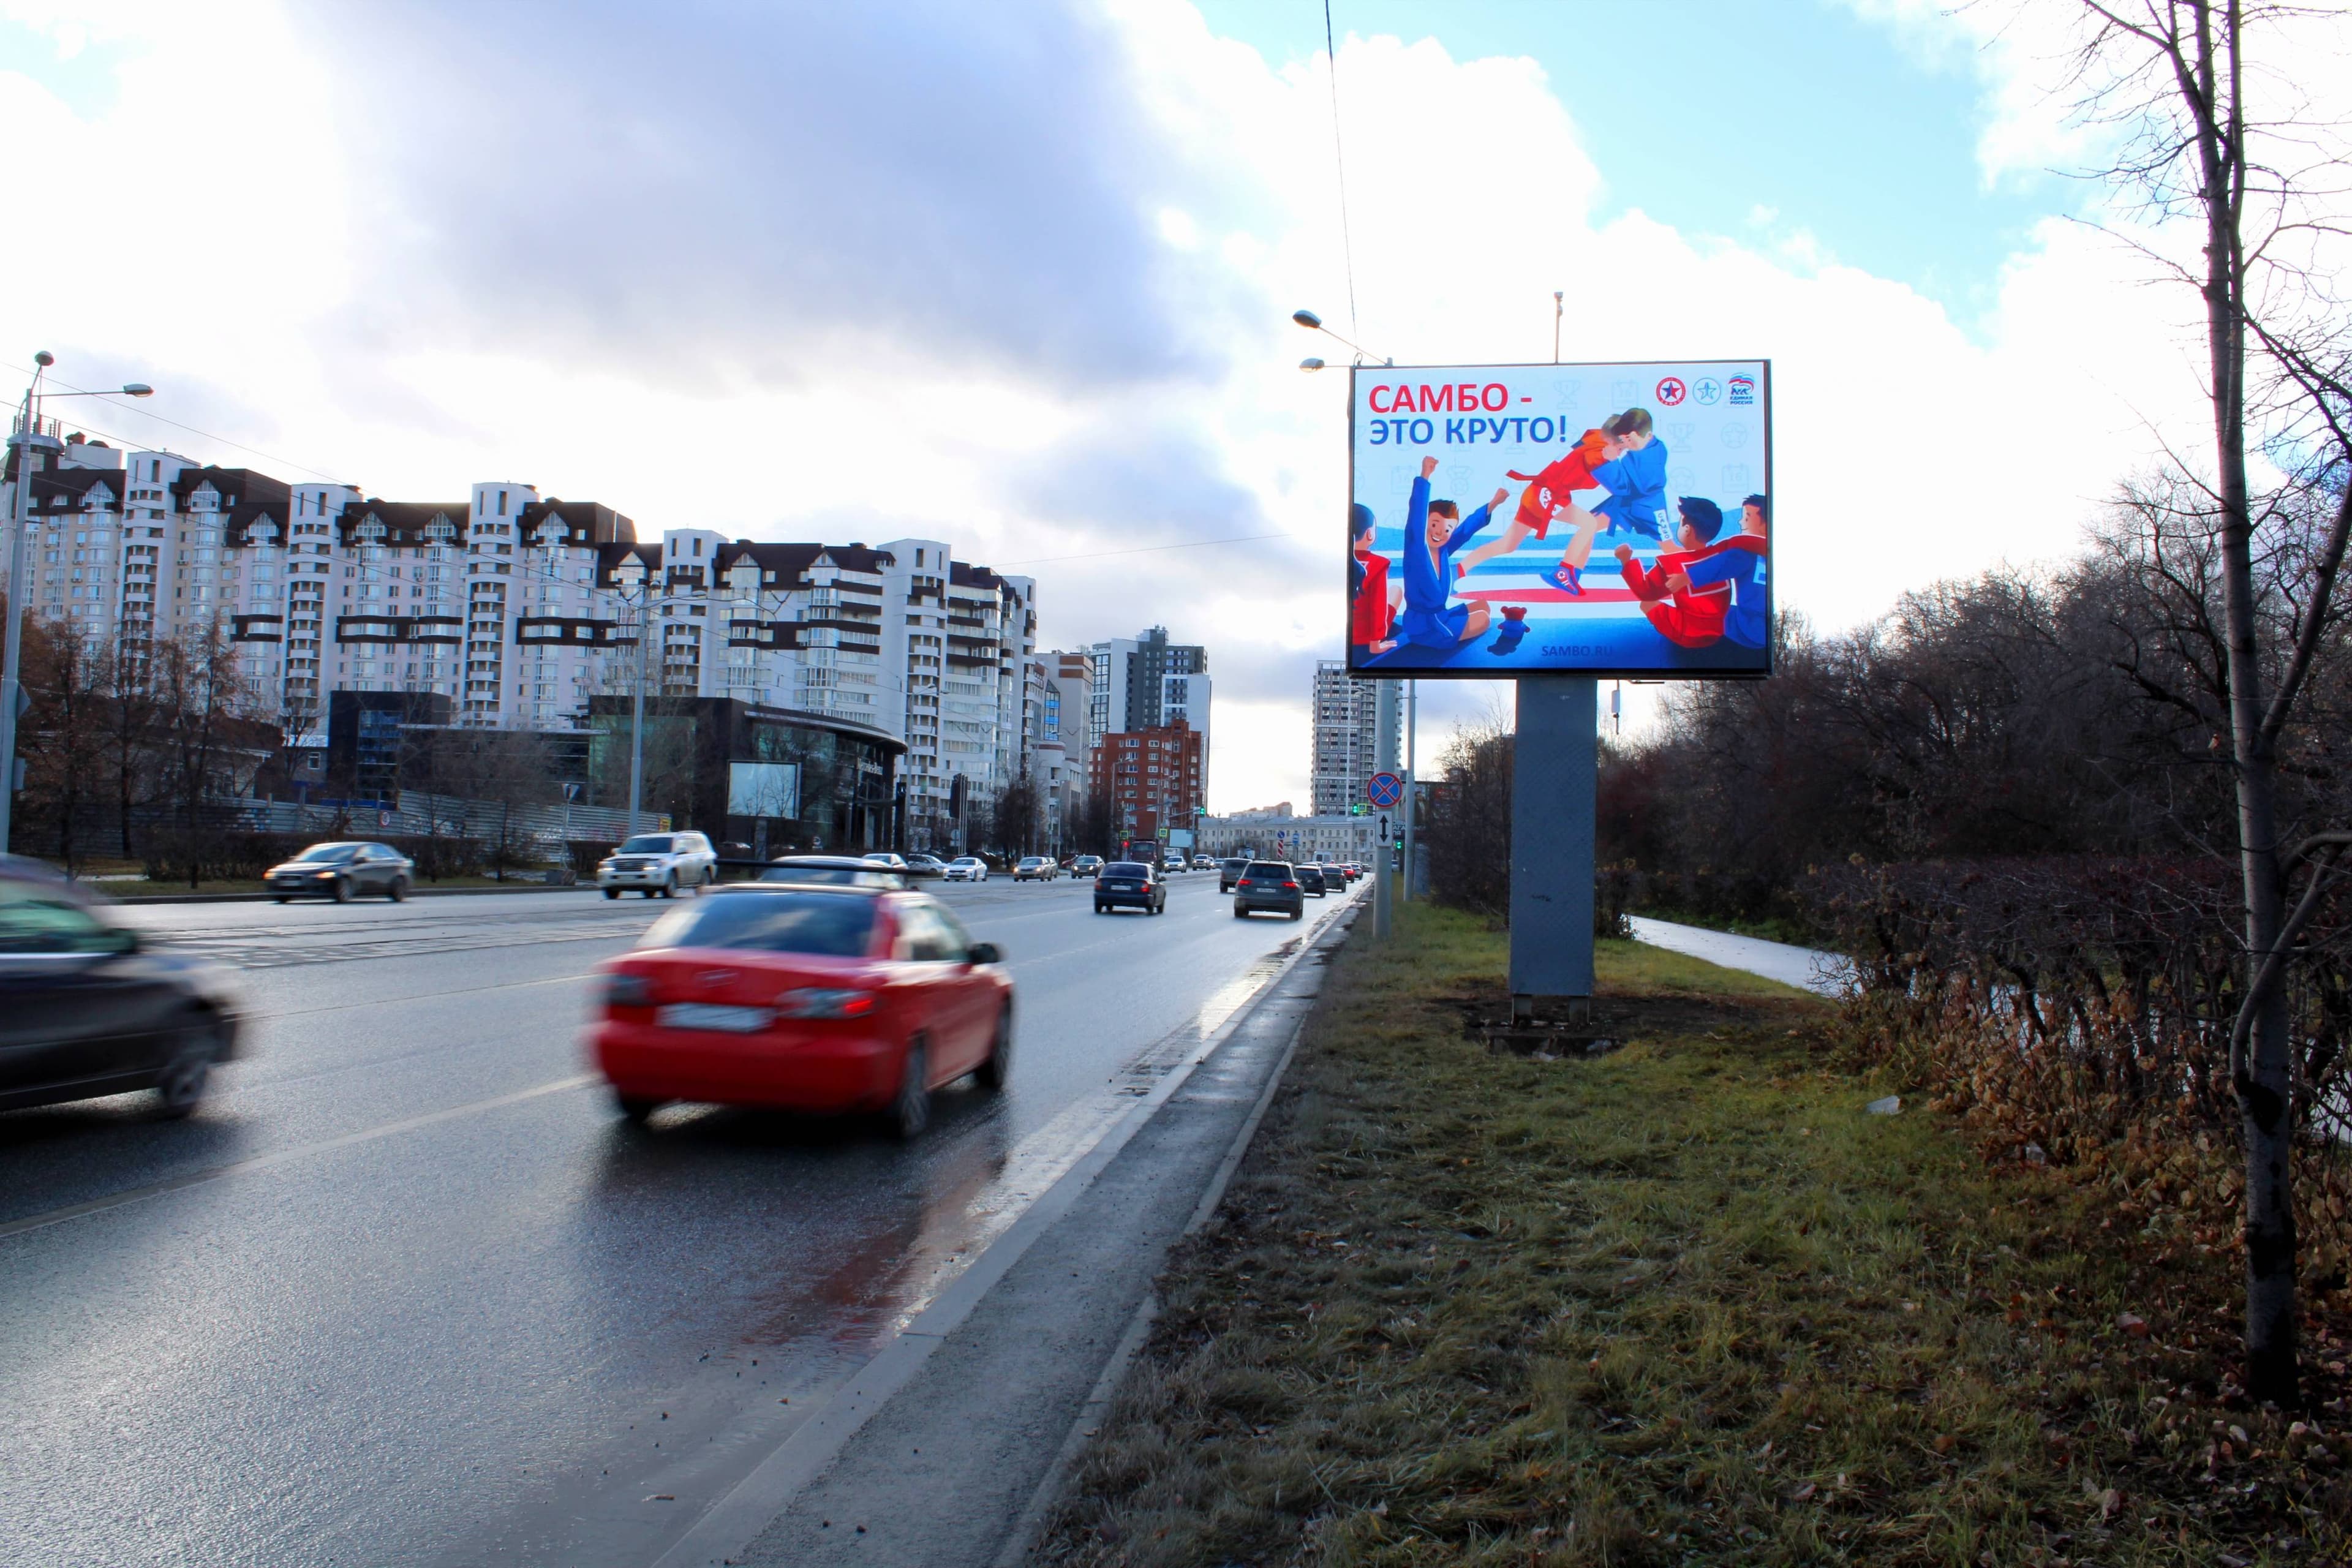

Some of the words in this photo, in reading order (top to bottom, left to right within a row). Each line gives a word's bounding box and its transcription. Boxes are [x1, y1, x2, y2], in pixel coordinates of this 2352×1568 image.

[1369, 383, 1509, 413] САМБО
[1370, 418, 1434, 445] ЭТО
[1446, 415, 1566, 444] КРУТО!
[1541, 646, 1613, 657] SAMBO.RU
